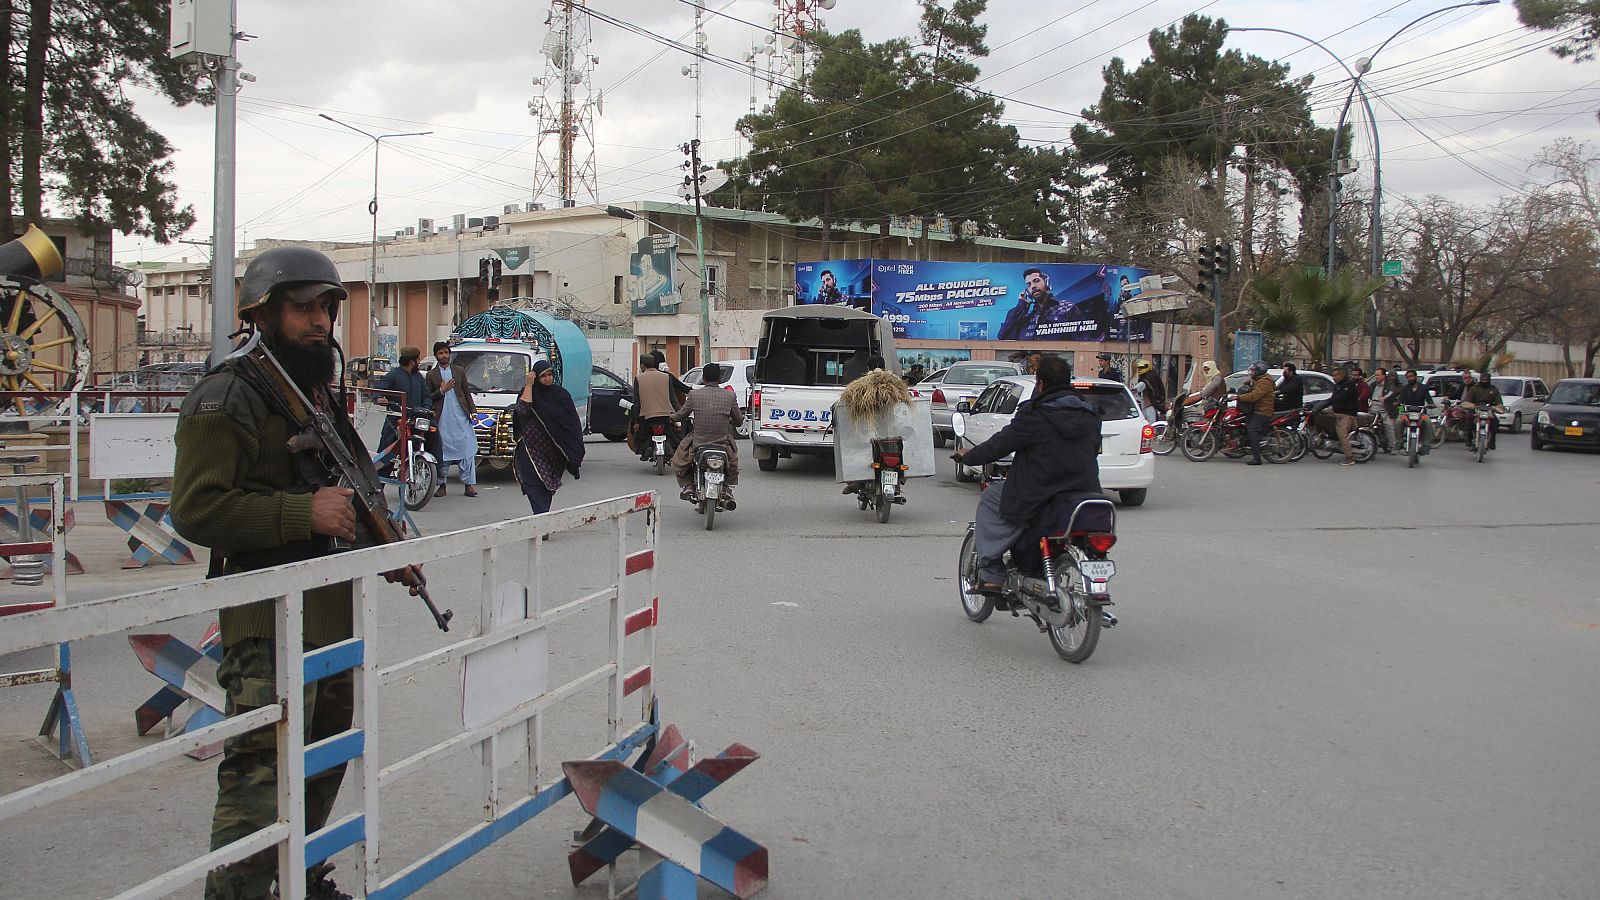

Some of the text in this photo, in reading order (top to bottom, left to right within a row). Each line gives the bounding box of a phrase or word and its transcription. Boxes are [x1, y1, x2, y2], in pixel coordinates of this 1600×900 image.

[915, 279, 991, 292] ALL ROUNDER
[895, 285, 1008, 303] 75Mbps PACKAGE
[1052, 320, 1081, 328] INTERNET
